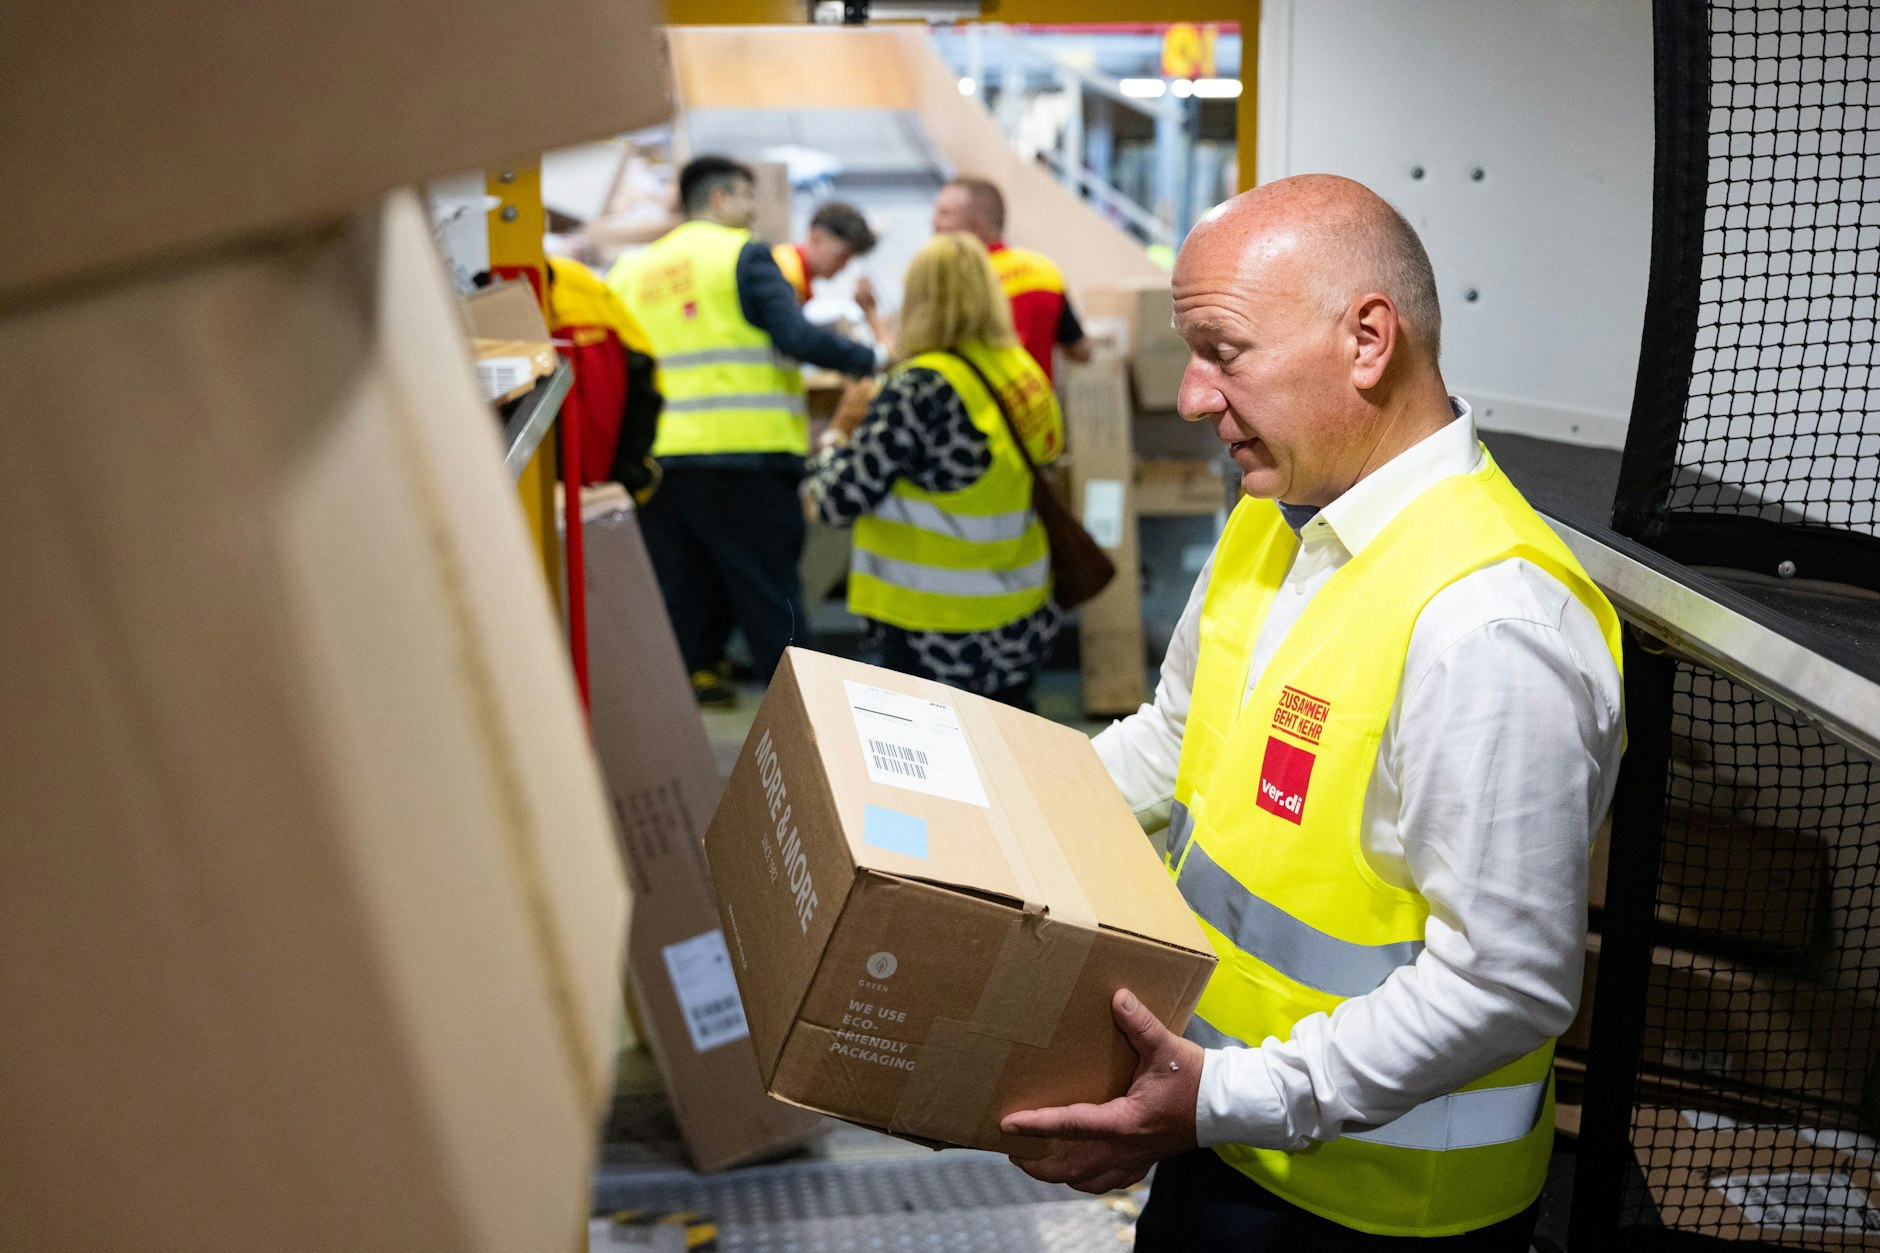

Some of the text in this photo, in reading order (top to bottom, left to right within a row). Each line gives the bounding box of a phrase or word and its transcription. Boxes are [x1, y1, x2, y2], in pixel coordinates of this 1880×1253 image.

[1273, 707, 1299, 729] GEHT
[1261, 777, 1303, 814] ver.di
[755, 728, 818, 935] MORE & MORE
[858, 979, 889, 992] GREEN
[842, 1014, 878, 1030] ECO-
[849, 1000, 907, 1023] WE USE
[835, 1029, 908, 1053] FRIENDLY
[830, 1042, 916, 1071] PACKAGING
